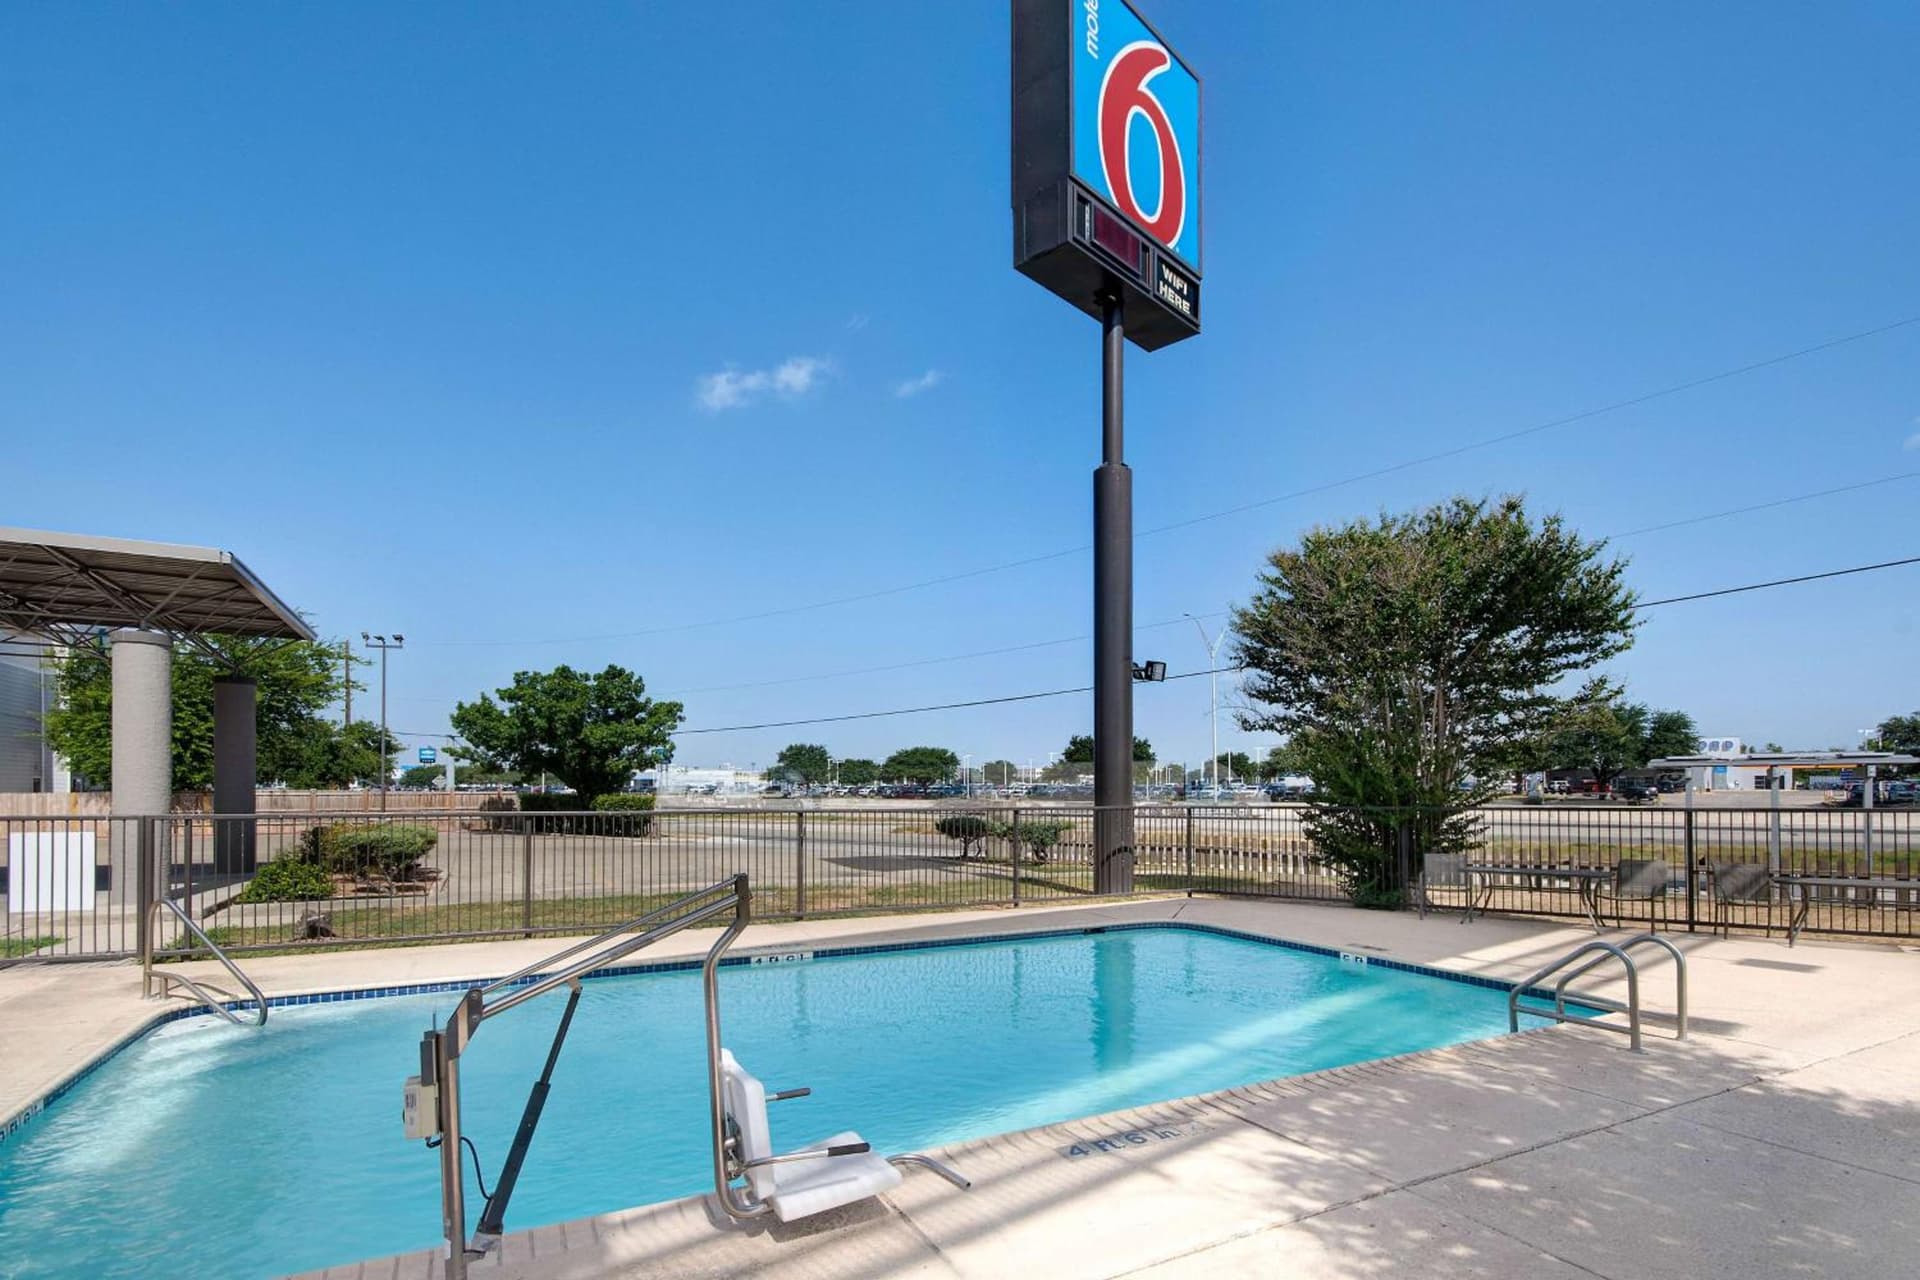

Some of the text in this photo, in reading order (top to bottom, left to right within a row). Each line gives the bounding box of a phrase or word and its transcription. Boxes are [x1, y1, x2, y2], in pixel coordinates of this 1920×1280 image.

[1097, 40, 1185, 250] 6
[1160, 280, 1190, 314] HERE
[1070, 1144, 1090, 1156] 4
[1124, 1131, 1148, 1144] 6
